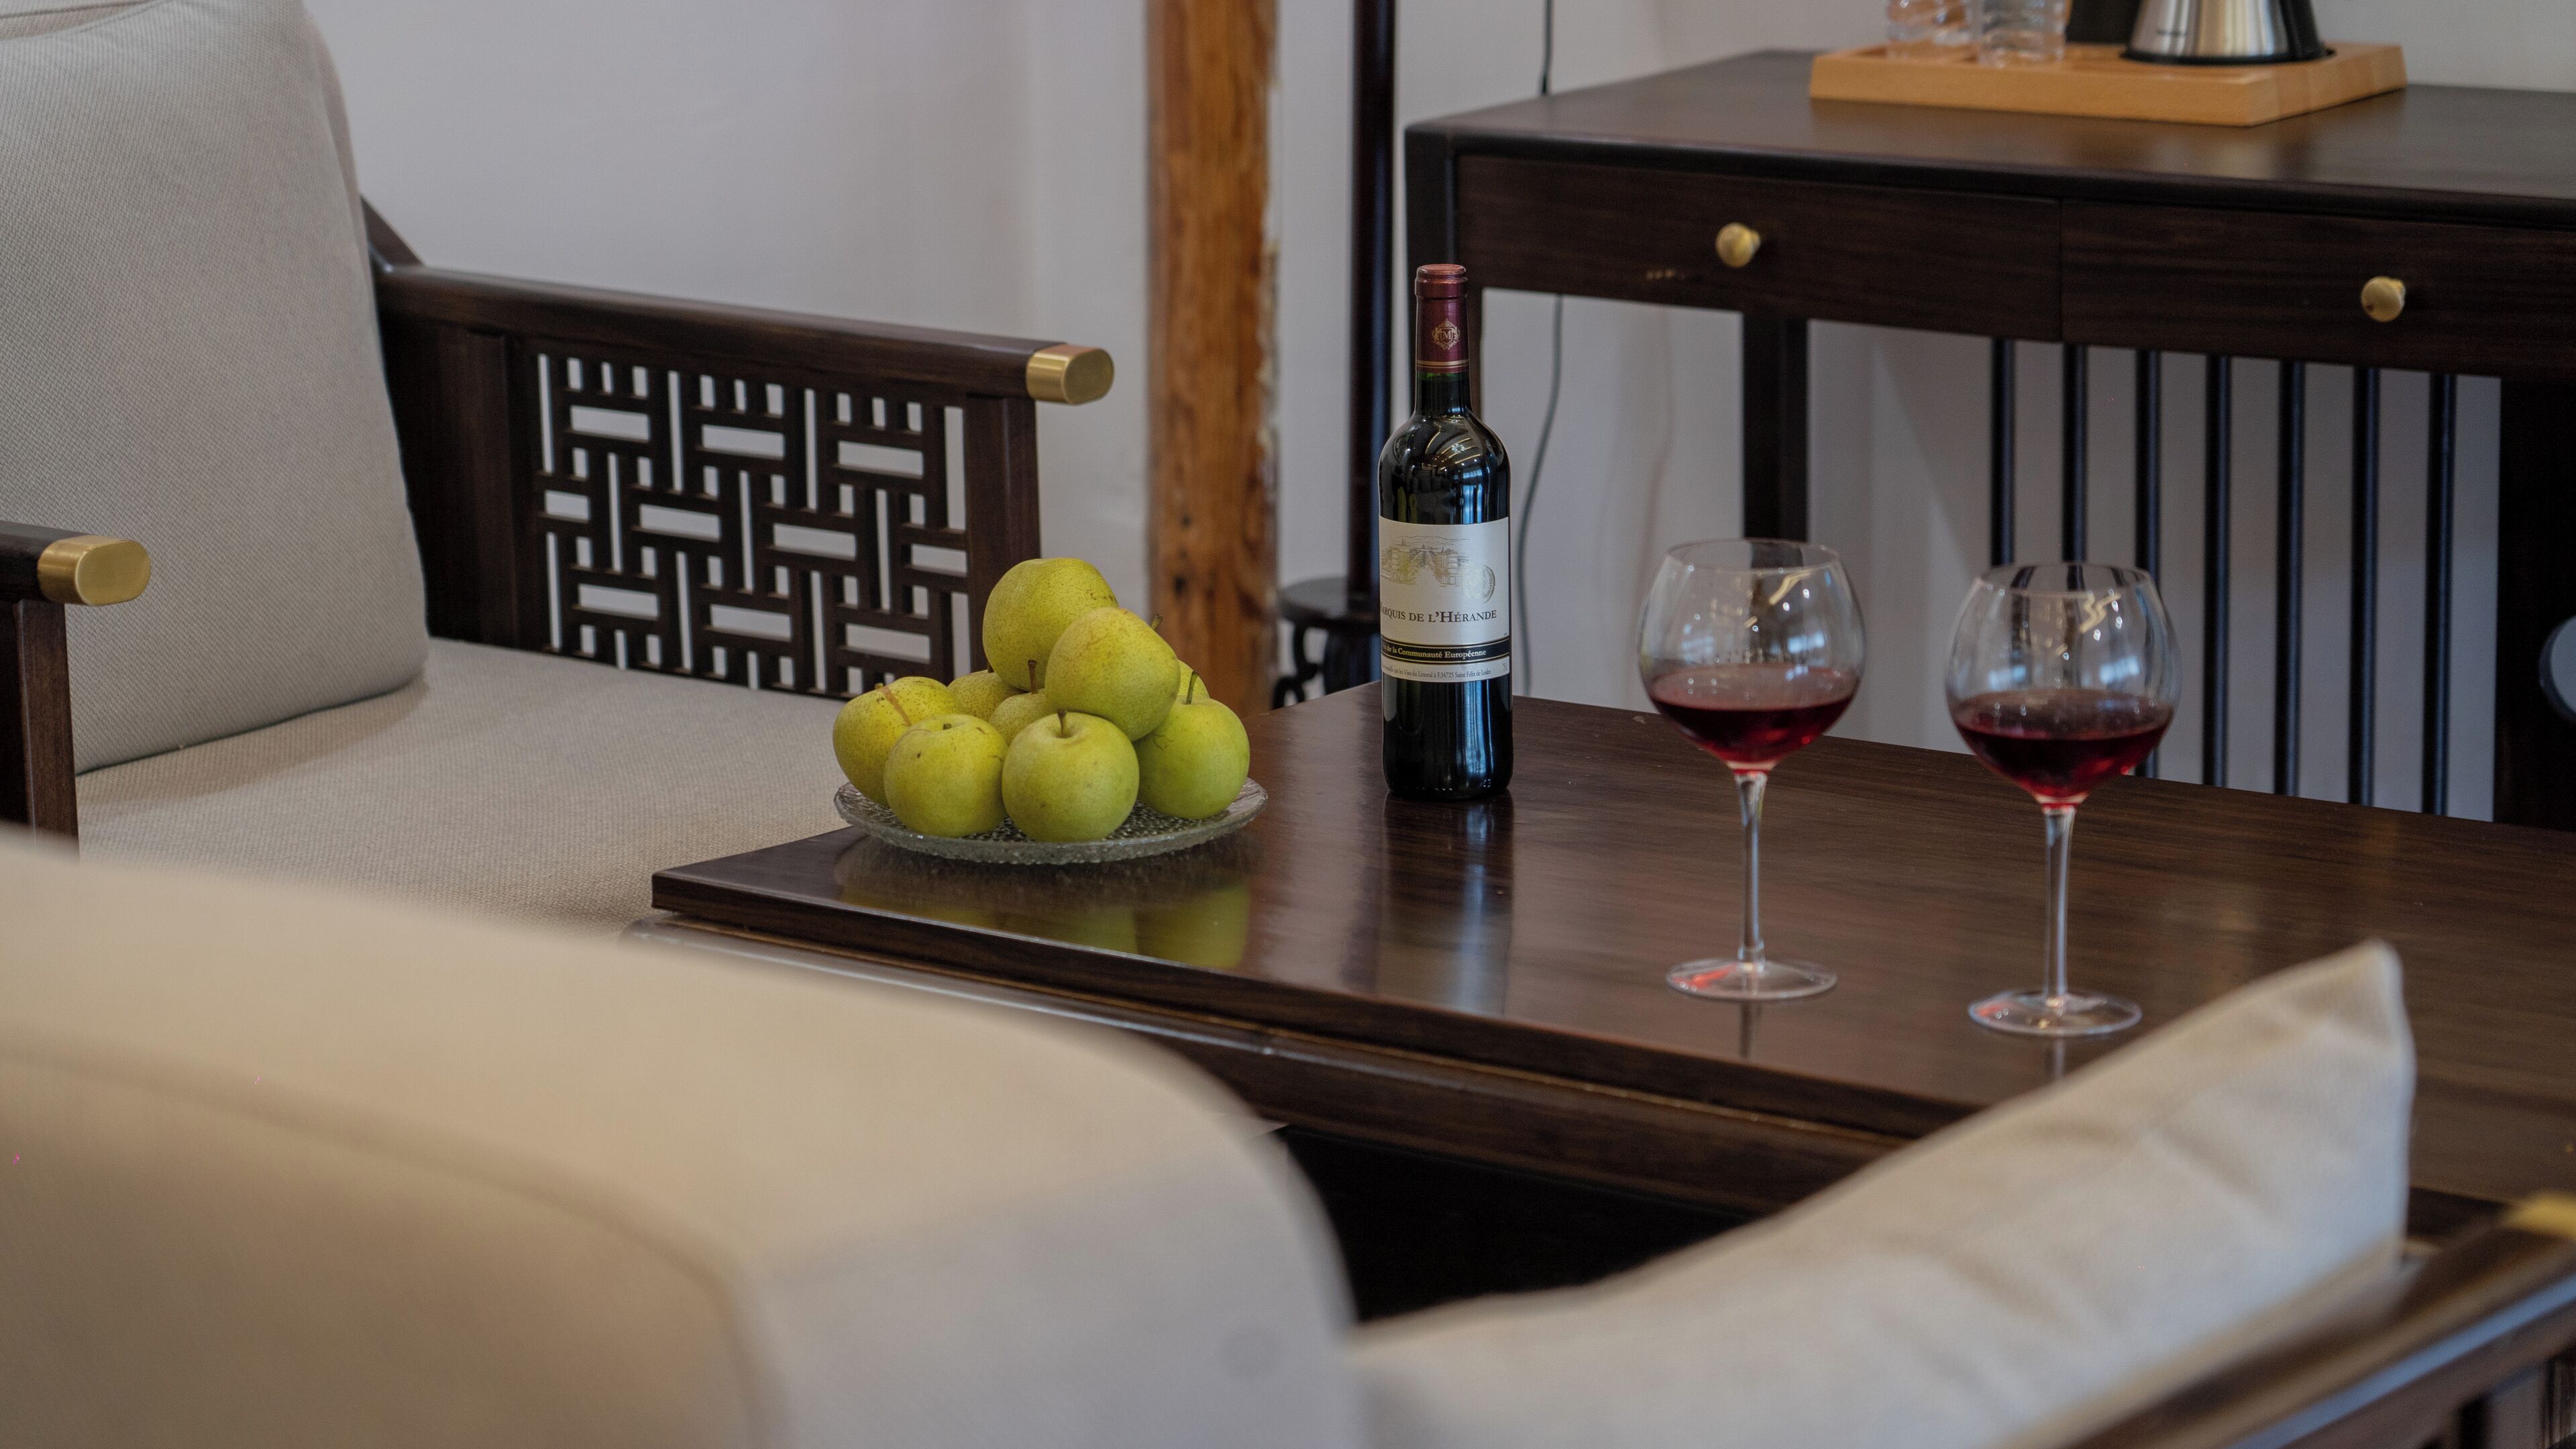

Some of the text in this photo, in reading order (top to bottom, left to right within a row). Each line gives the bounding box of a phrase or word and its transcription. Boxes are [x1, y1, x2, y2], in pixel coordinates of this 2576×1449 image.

[1442, 331, 1451, 339] M
[1409, 612, 1424, 622] DE
[1398, 647, 1443, 658] Communauté
[1444, 650, 1487, 659] Européenne
